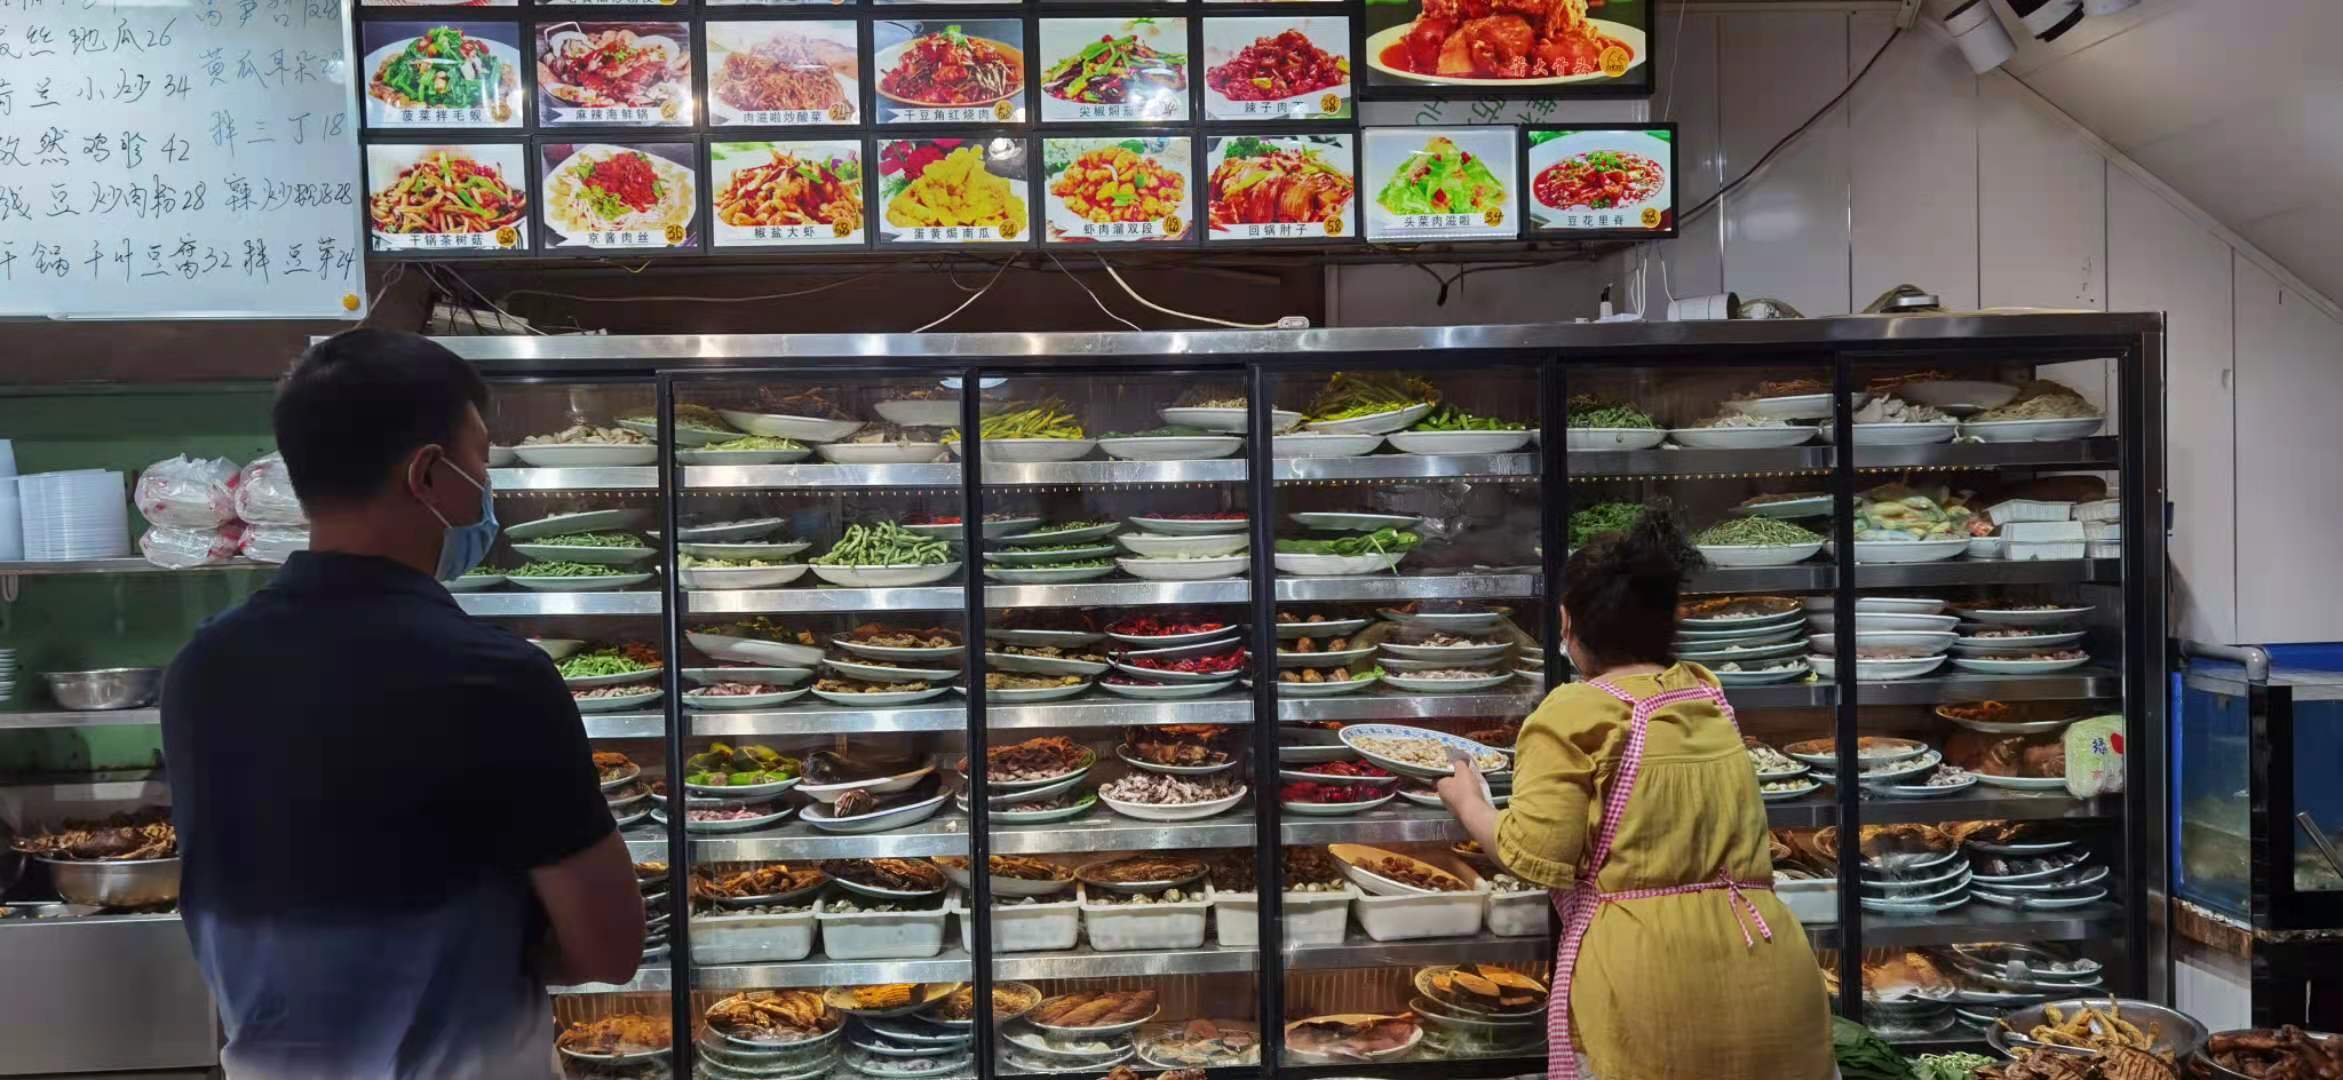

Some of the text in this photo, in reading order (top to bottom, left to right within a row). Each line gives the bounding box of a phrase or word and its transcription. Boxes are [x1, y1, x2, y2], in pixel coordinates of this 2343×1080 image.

[576, 109, 649, 121] 麻辣海鲜锅
[904, 109, 989, 121] 干豆角红烧肉
[754, 226, 816, 239] 椒盐大虾
[914, 227, 991, 240] 蛋黄焗南瓜
[1248, 223, 1308, 236] 回锅肘子
[410, 233, 484, 247] 干锅茶树菇
[589, 232, 649, 244] 京酱肉丝
